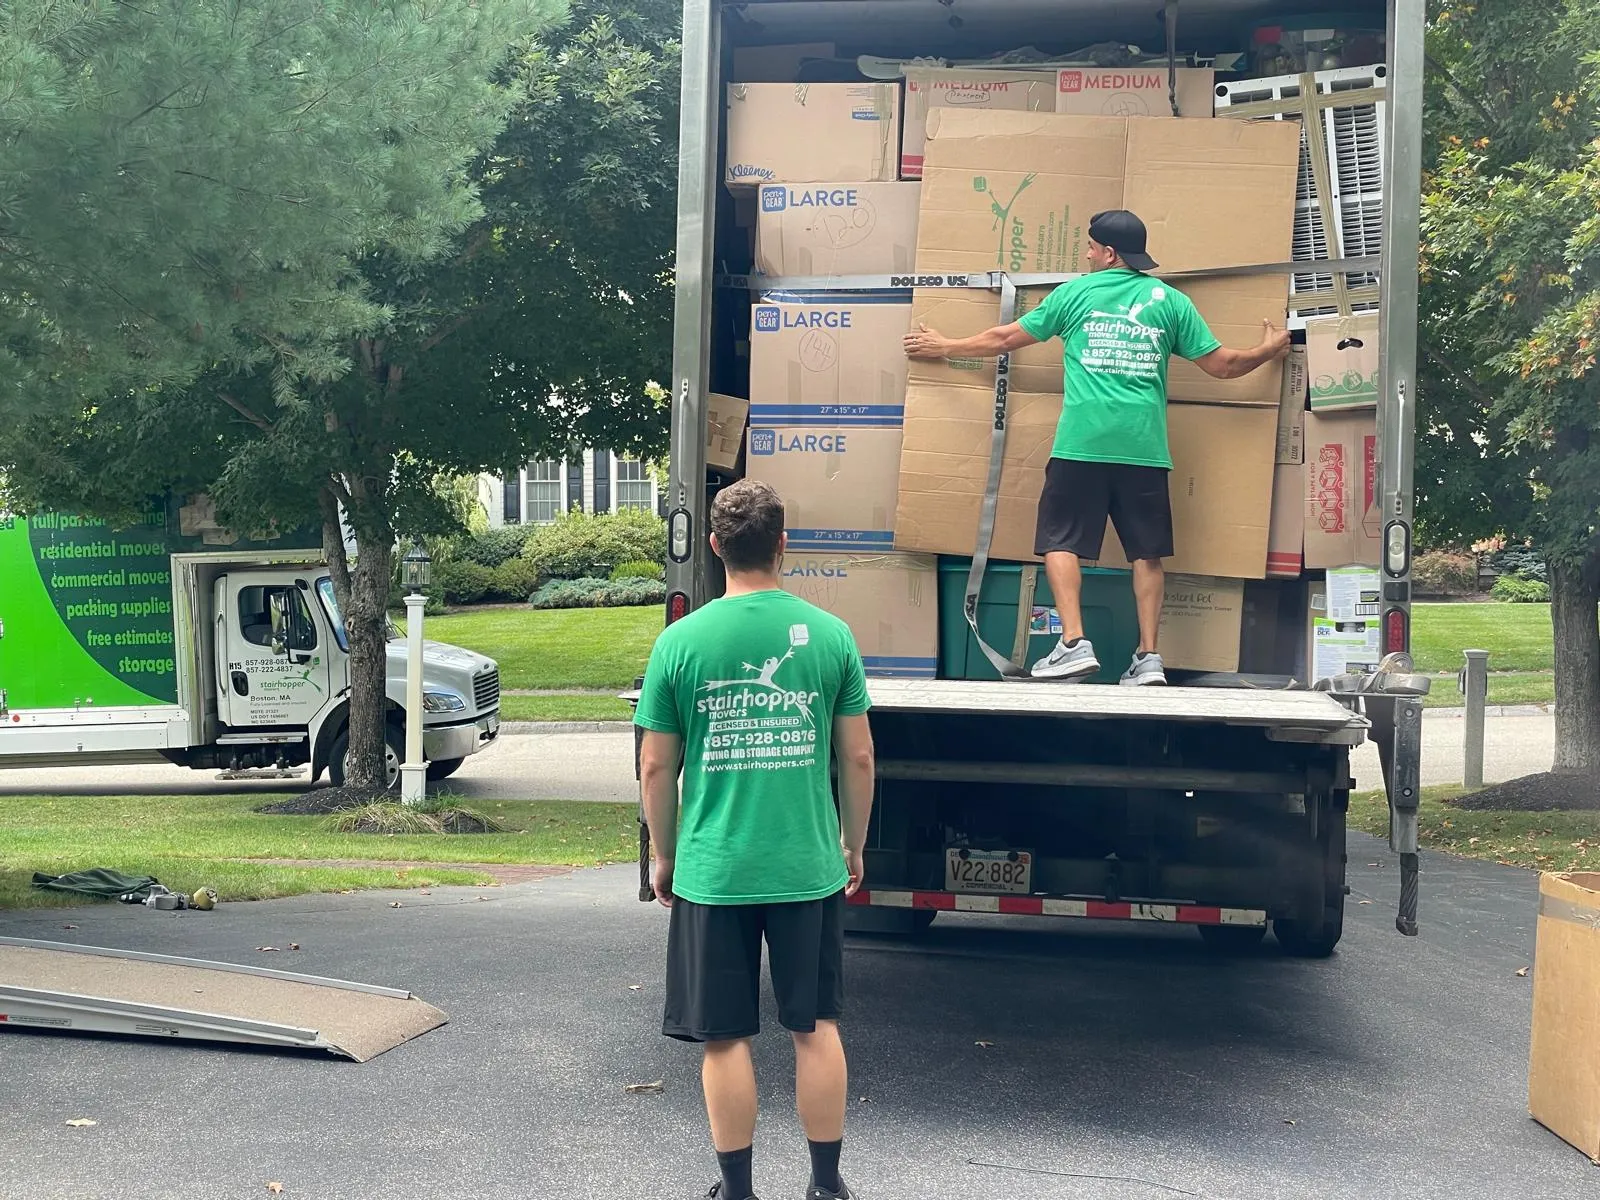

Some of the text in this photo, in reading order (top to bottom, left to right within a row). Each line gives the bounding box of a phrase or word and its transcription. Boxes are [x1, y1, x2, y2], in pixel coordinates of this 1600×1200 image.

[1085, 75, 1161, 89] MEDIUM
[729, 163, 773, 180] Kleenex
[765, 198, 783, 208] GEAR
[790, 190, 857, 207] LARGE
[891, 275, 943, 287] DOLECO
[759, 318, 777, 328] GEAR
[783, 311, 851, 328] LARGE
[1082, 320, 1165, 339] stairhopper
[995, 379, 1007, 430] DOLECO
[754, 440, 772, 451] GEAR
[779, 434, 847, 452] LARGE
[40, 540, 166, 559] residential moves
[51, 569, 170, 588] commercial moves
[66, 596, 171, 620] packing supplies
[87, 630, 173, 646] free estimates
[119, 656, 174, 675] storage
[229, 662, 242, 670] H15
[246, 666, 293, 674] 857-222-4837
[260, 680, 305, 690] stairhopper
[697, 688, 819, 713] stairhopper
[708, 708, 748, 720] movers
[750, 720, 756, 728] &
[760, 718, 800, 726] INSURED
[711, 730, 816, 748] 857-928-0876
[730, 748, 746, 758] AND
[746, 746, 782, 758] STORAGE
[706, 758, 815, 772] www.stairhoppers.com
